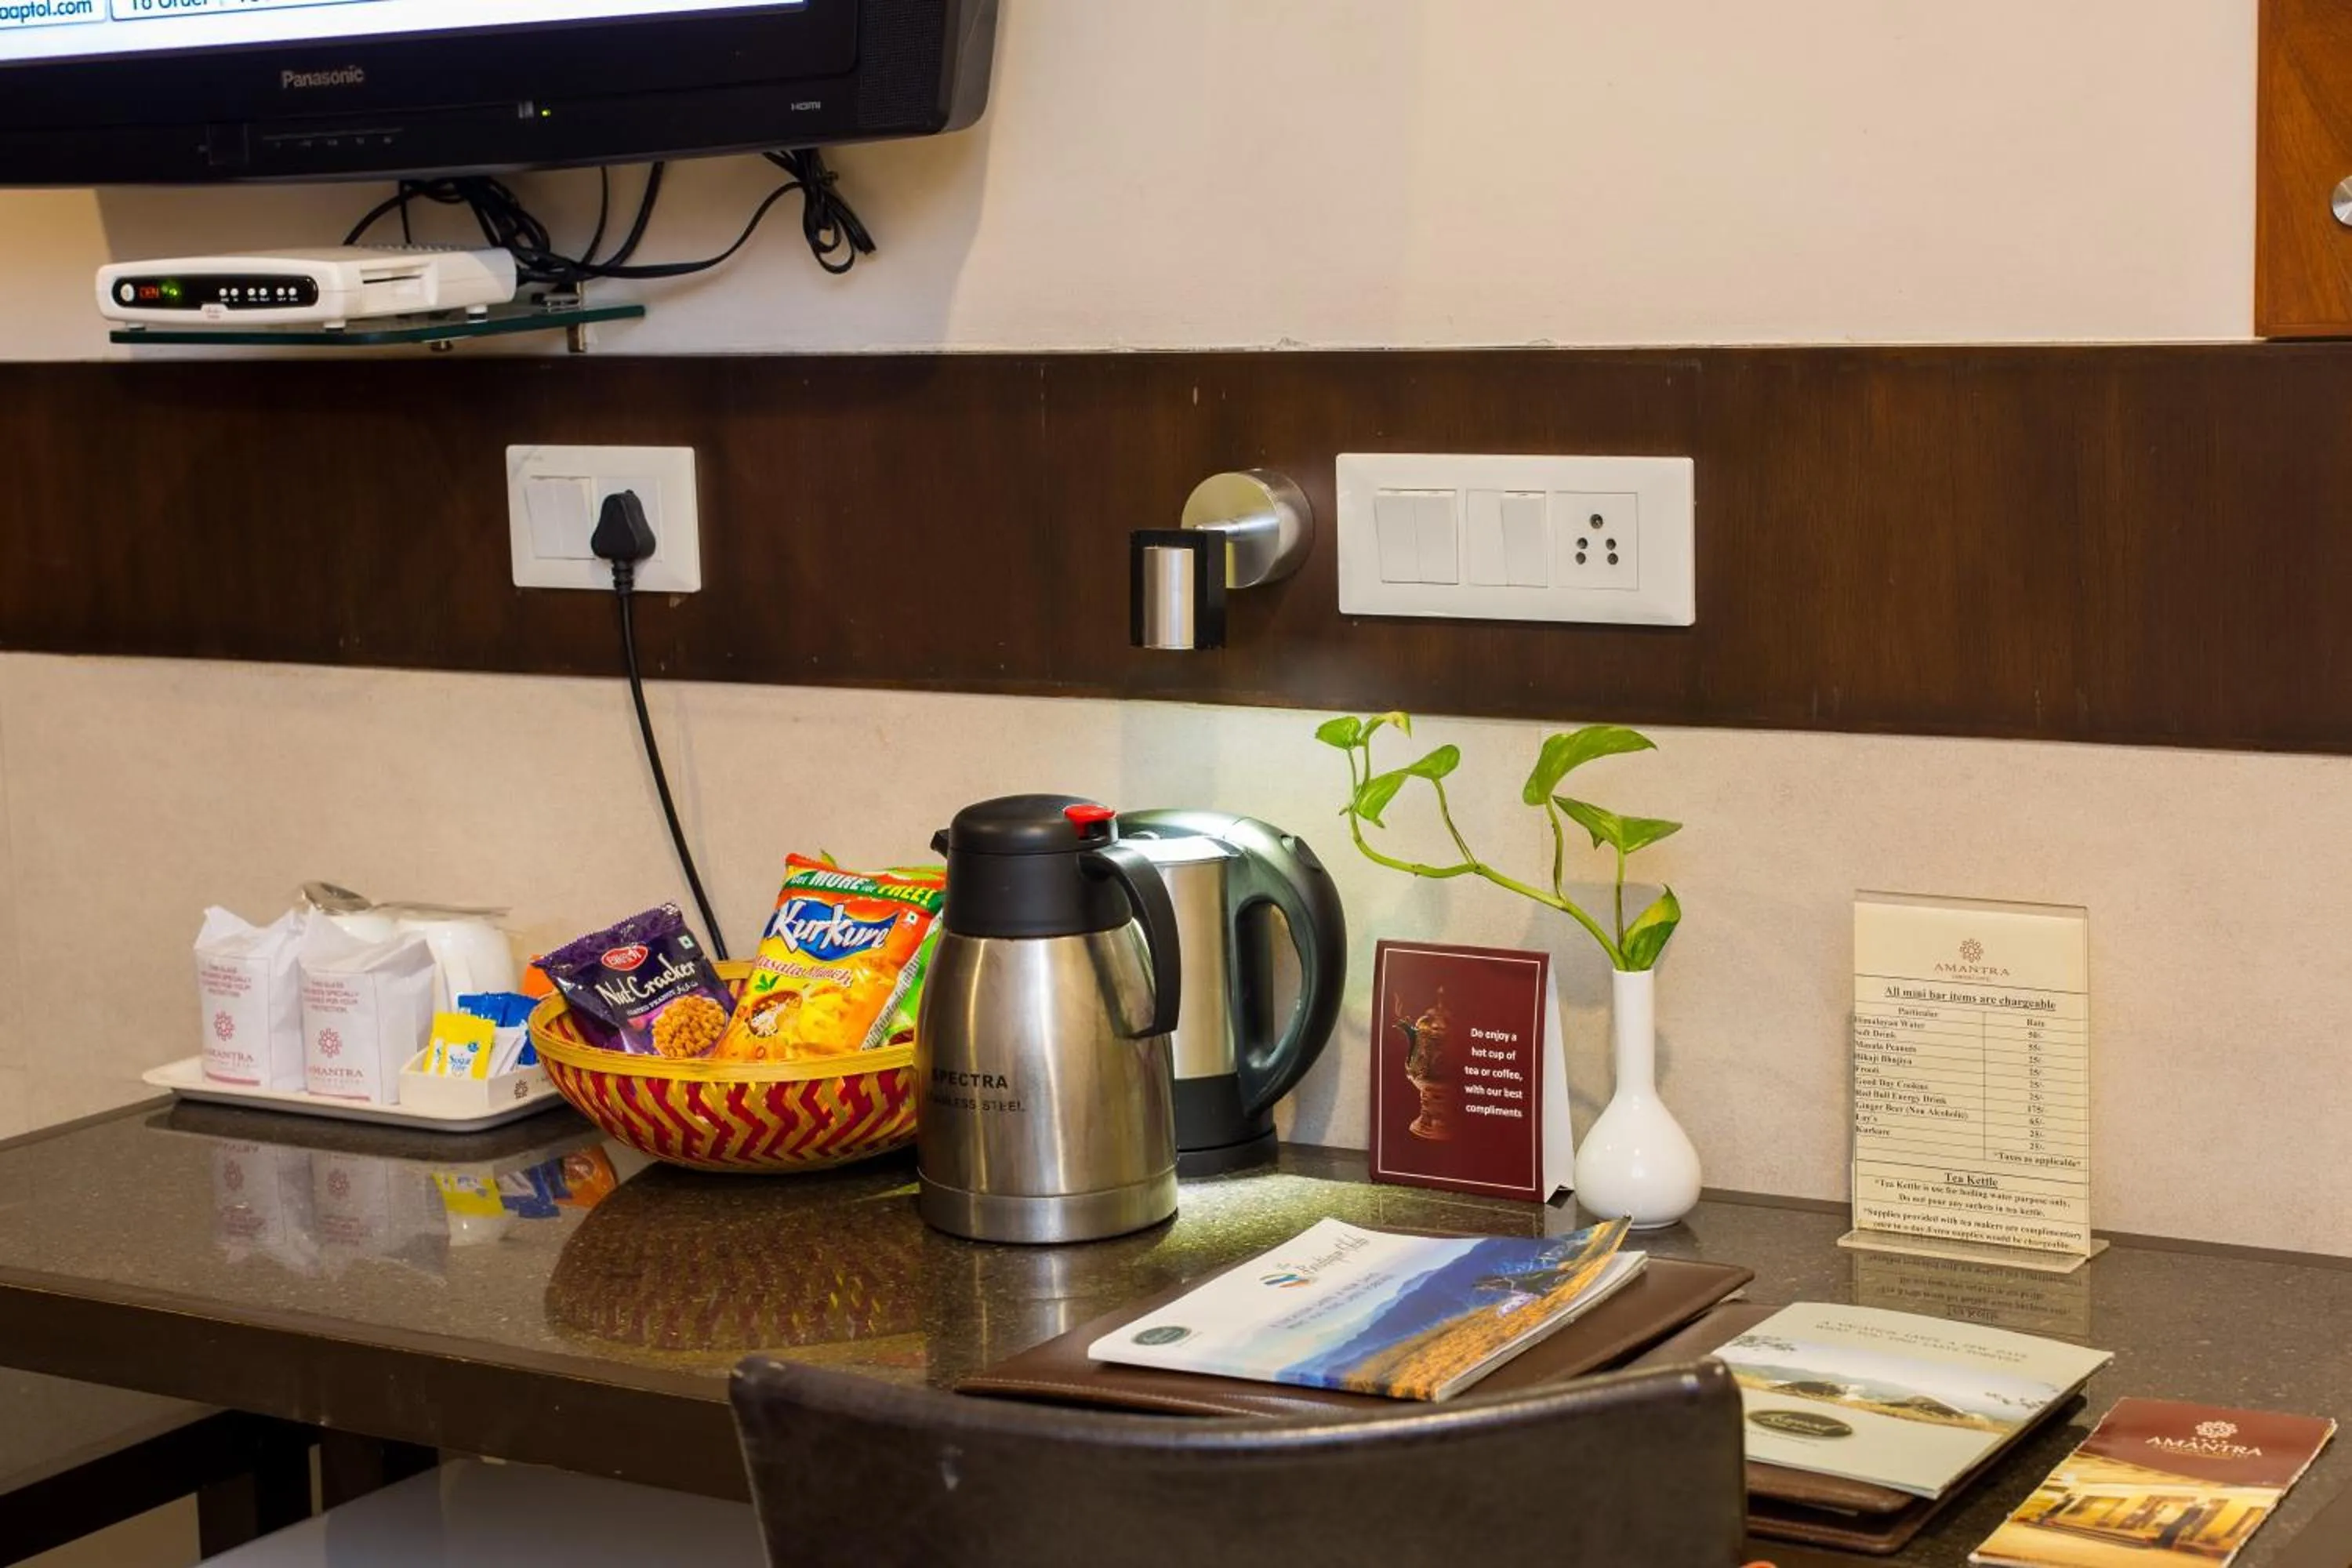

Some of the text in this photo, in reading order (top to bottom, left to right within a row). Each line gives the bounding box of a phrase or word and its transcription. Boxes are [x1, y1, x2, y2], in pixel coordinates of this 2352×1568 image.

[281, 64, 365, 88] Panasonic
[791, 101, 821, 111] HDMI
[809, 870, 865, 891] MORE
[877, 884, 935, 906] FREE!
[766, 900, 891, 953] Kurkure
[1933, 963, 2010, 976] AMANTRA
[1884, 985, 2056, 1011] All mini bar items are chargeable
[1900, 1020, 1926, 1029] Water
[1471, 1028, 1483, 1038] Do
[1485, 1030, 1509, 1043] enjoy
[1472, 1047, 1516, 1061] hot cup of
[931, 1068, 1008, 1090] SPECTRA
[1465, 1066, 1479, 1075] tea
[1492, 1069, 1523, 1082] coffee,
[1465, 1085, 1523, 1099] with our best
[1893, 1092, 1920, 1104] Energy
[1465, 1104, 1523, 1118] compliments
[1886, 1103, 1904, 1112] Beer
[1944, 1172, 1998, 1188] Tea Kettle
[1896, 1180, 1921, 1190] Kettle
[1990, 1192, 2013, 1200] water
[2144, 1436, 2262, 1457] AMANTRA
